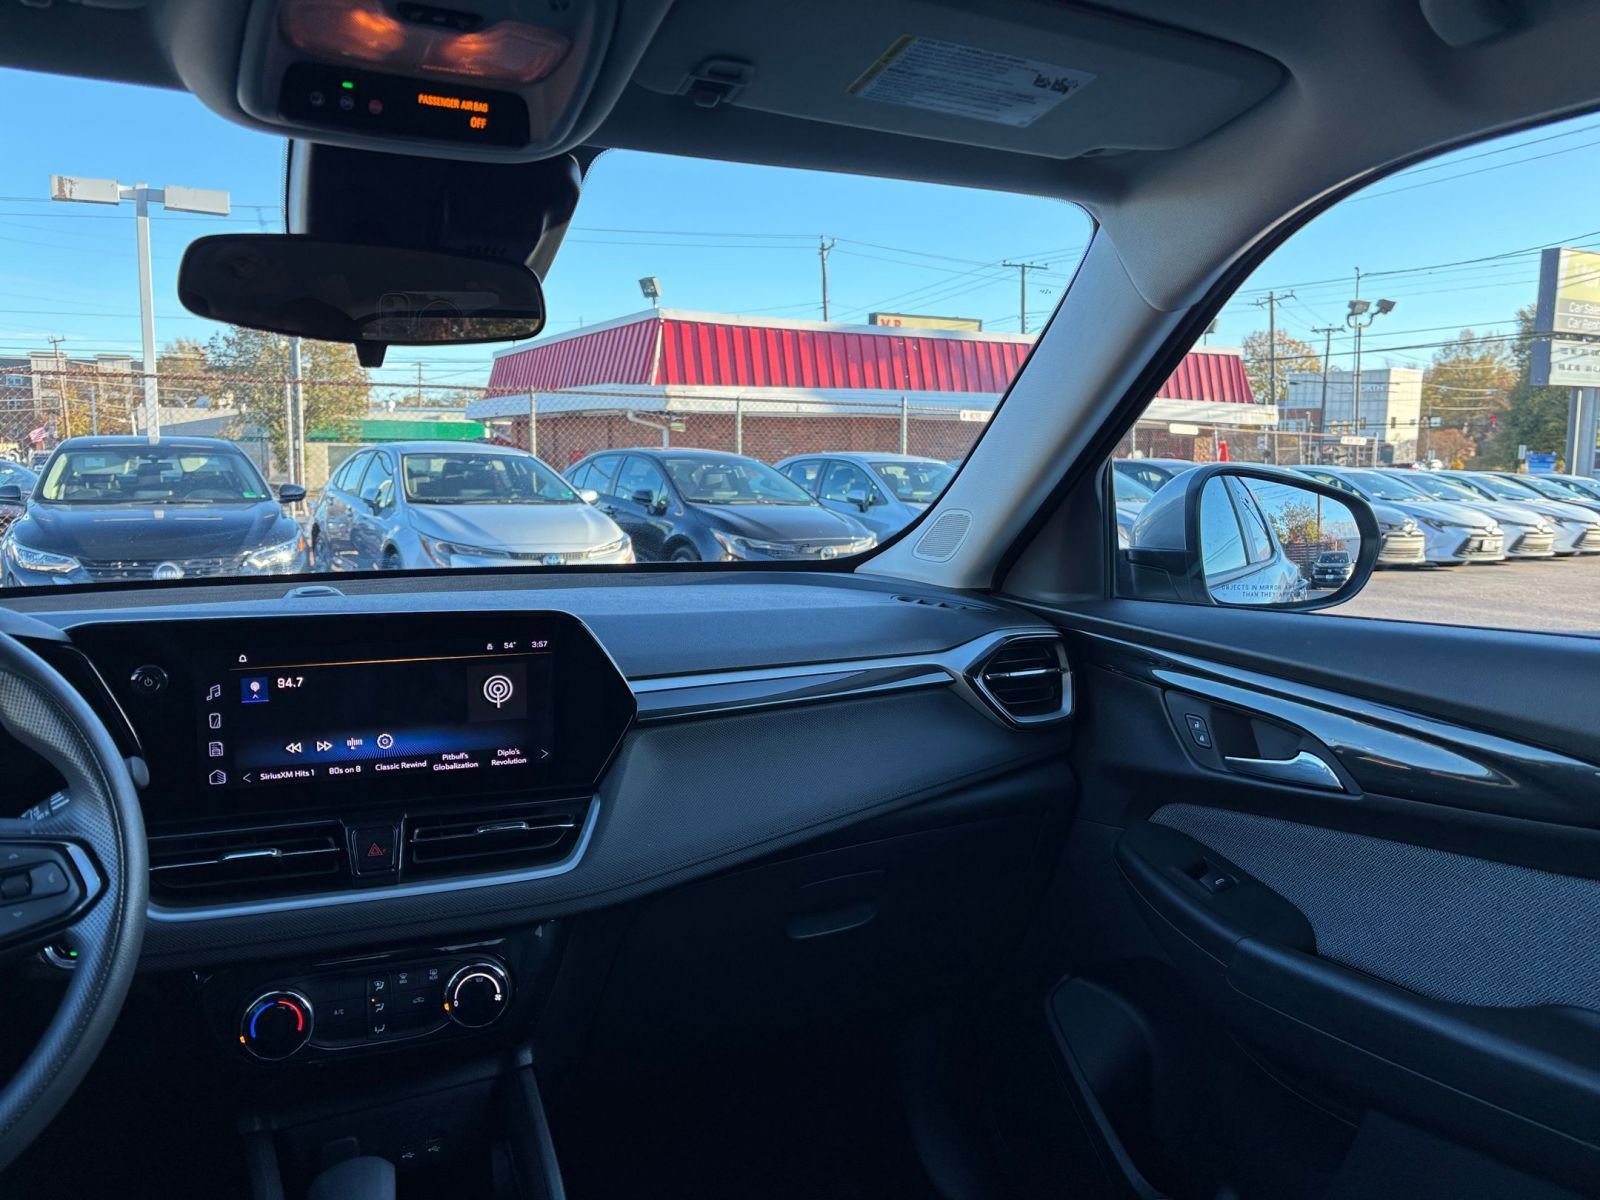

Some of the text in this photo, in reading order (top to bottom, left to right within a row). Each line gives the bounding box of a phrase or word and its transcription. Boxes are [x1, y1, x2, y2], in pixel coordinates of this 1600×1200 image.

[418, 94, 459, 108] PASSENGER
[470, 116, 487, 128] OFF
[1569, 302, 1584, 313] Car
[1567, 317, 1582, 328] Car
[531, 640, 548, 648] 3:57
[277, 676, 304, 688] 94.7
[441, 751, 469, 761] Pitbull's
[497, 747, 521, 757] Diplo's
[374, 759, 427, 771] Classic Rewind
[432, 760, 479, 771] Globalization
[491, 756, 527, 767] Revolution
[260, 770, 294, 781] SiriusXM
[294, 769, 310, 778] Hits
[328, 766, 344, 775] 80s
[355, 765, 361, 773] 8
